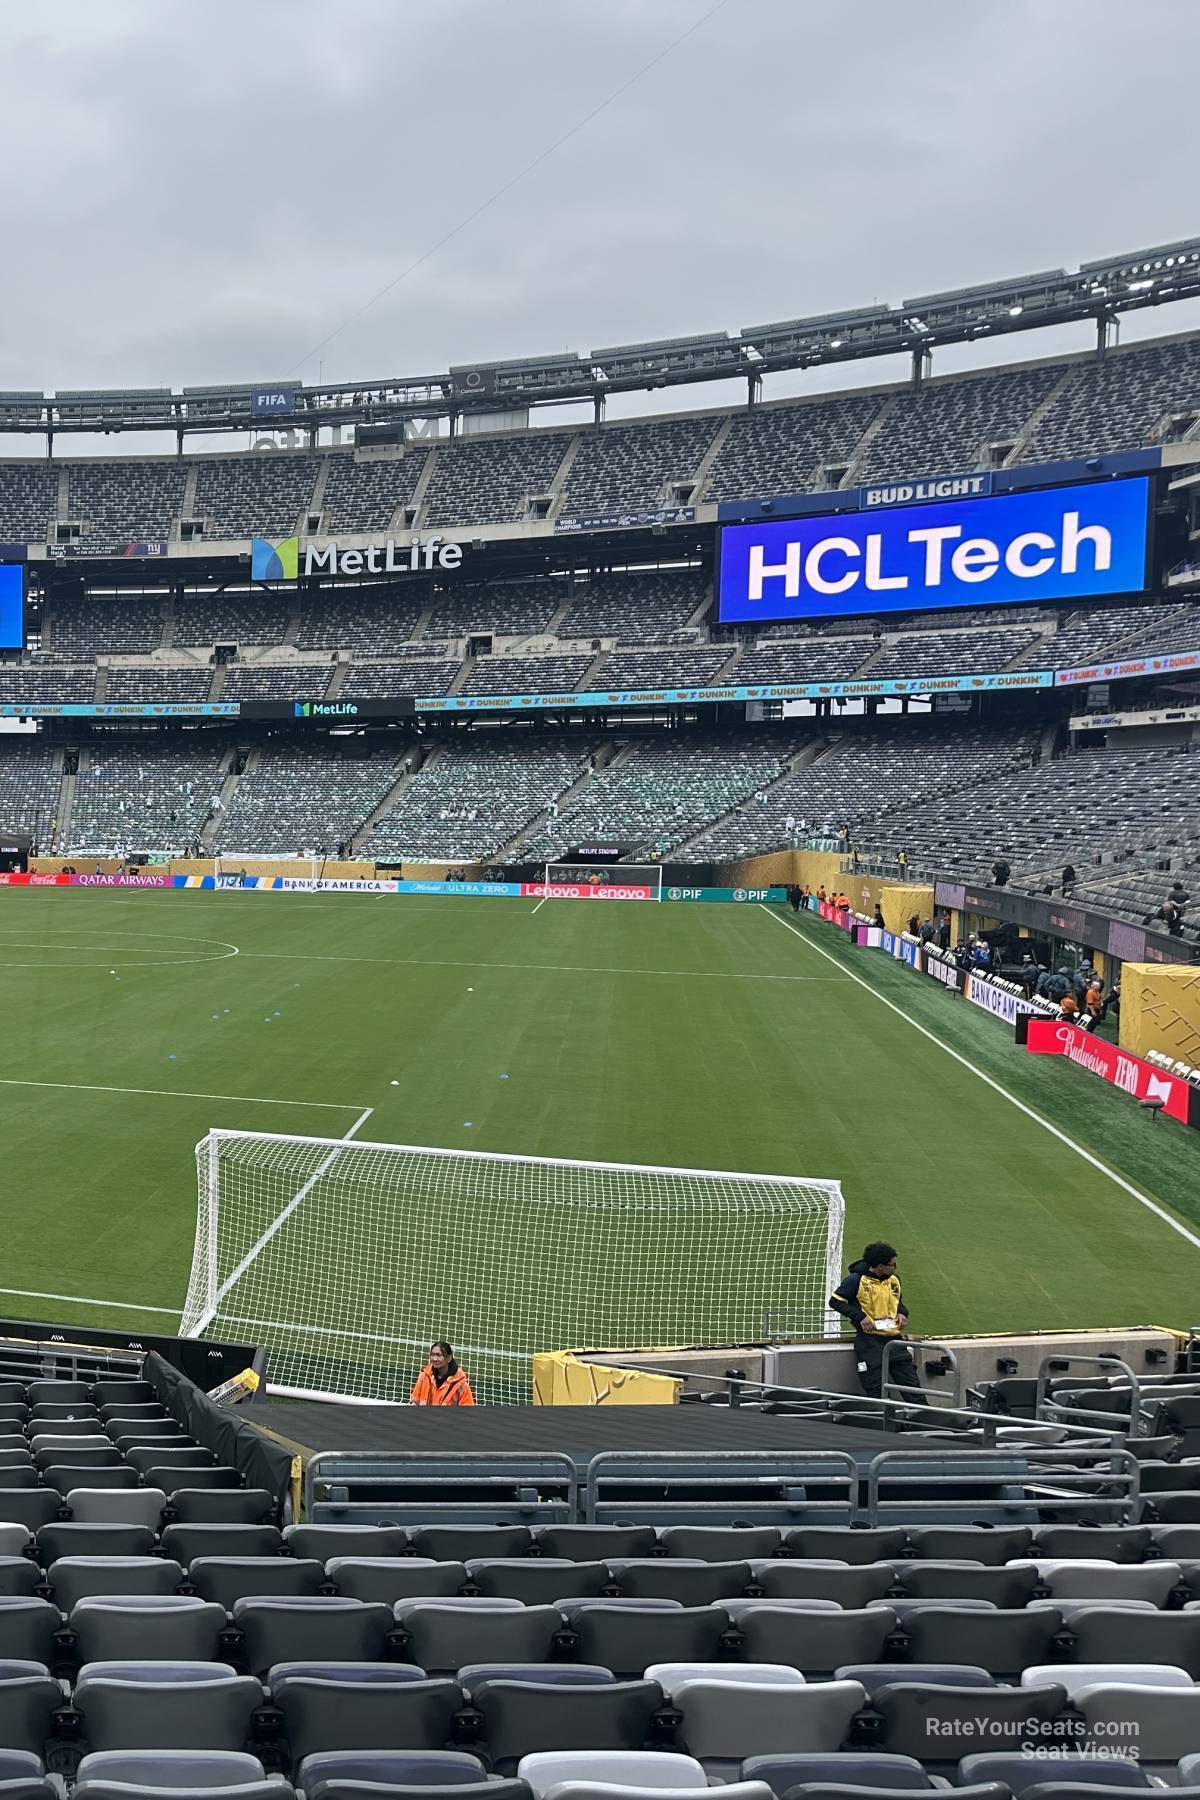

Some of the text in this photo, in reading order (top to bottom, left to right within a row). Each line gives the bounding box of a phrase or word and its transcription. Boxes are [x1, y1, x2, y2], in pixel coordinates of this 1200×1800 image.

[258, 394, 286, 406] FIFA
[866, 477, 983, 506] BUD LIGHT
[304, 535, 463, 576] MetLife
[748, 512, 1112, 601] HCLTech
[313, 703, 358, 715] MetLife
[79, 875, 164, 886] QATAR AIRWAYS
[284, 880, 313, 889] BANK
[331, 882, 381, 890] AMERICA
[448, 884, 479, 893] ULTRA
[482, 885, 508, 893] ZERO
[526, 885, 580, 897] Lenovo
[589, 886, 645, 898] Lenovo
[683, 889, 702, 899] PIF
[748, 890, 768, 900] PIF
[972, 980, 990, 1006] BANK
[992, 990, 1002, 1011] OF
[1056, 1027, 1140, 1095] Budweiser ZERO
